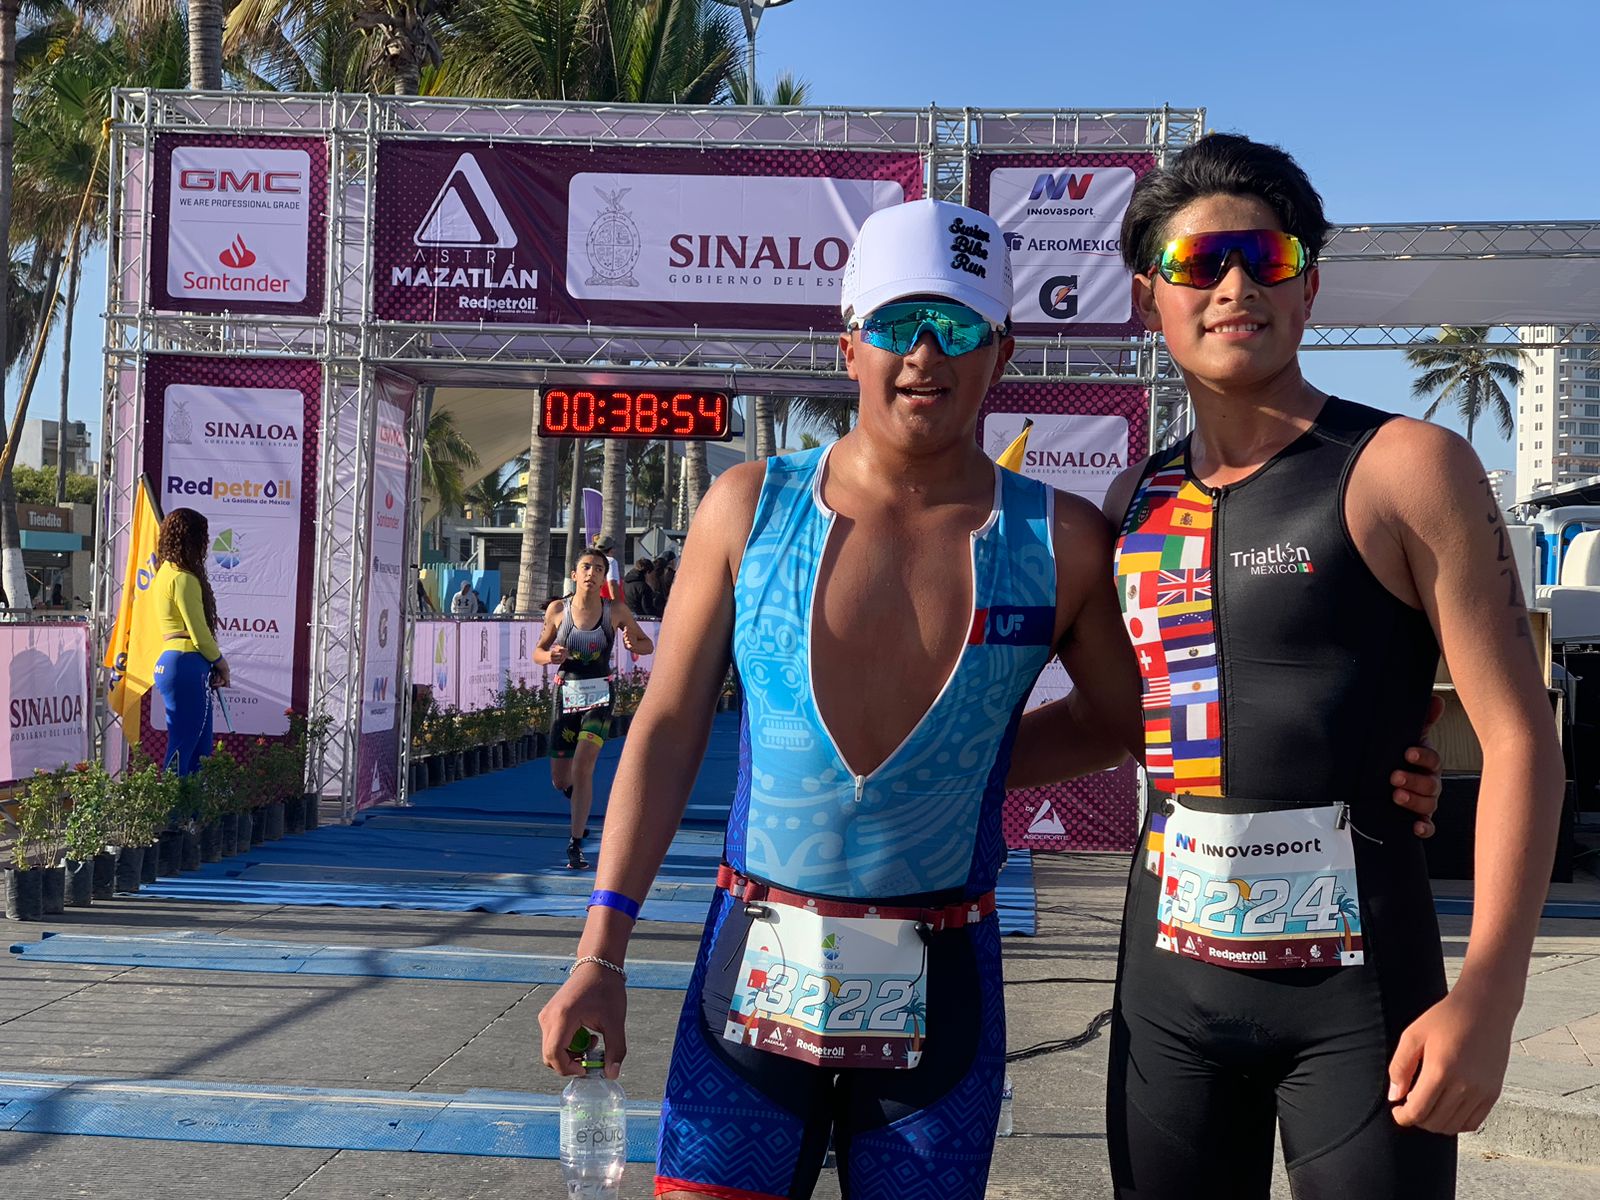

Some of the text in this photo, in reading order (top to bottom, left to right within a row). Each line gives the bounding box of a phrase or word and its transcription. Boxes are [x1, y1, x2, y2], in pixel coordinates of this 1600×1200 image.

[178, 168, 301, 194] GMC
[179, 198, 300, 210] WE ARE PROFESSIONAL GRADE
[668, 233, 848, 272] SINALO
[950, 235, 988, 260] Bike
[391, 263, 538, 289] MAZATLÁN
[950, 253, 986, 279] Run
[183, 271, 290, 293] Santander
[668, 273, 843, 288] GOBIERNO DEL EST
[545, 390, 722, 435] 00:38:54
[204, 421, 298, 441] SINALOA
[1025, 450, 1122, 469] SINALOA
[167, 476, 291, 500] Redpetroil
[231, 497, 257, 505] Gasolina
[268, 497, 290, 506] México
[28, 510, 62, 529] Tiendita
[214, 617, 279, 633] NALOA
[10, 695, 82, 728] SINALOA
[1025, 804, 1036, 813] by
[1023, 833, 1070, 841] ASDEPORTE
[1171, 869, 1341, 934] 3224
[754, 963, 915, 1031] 3222
